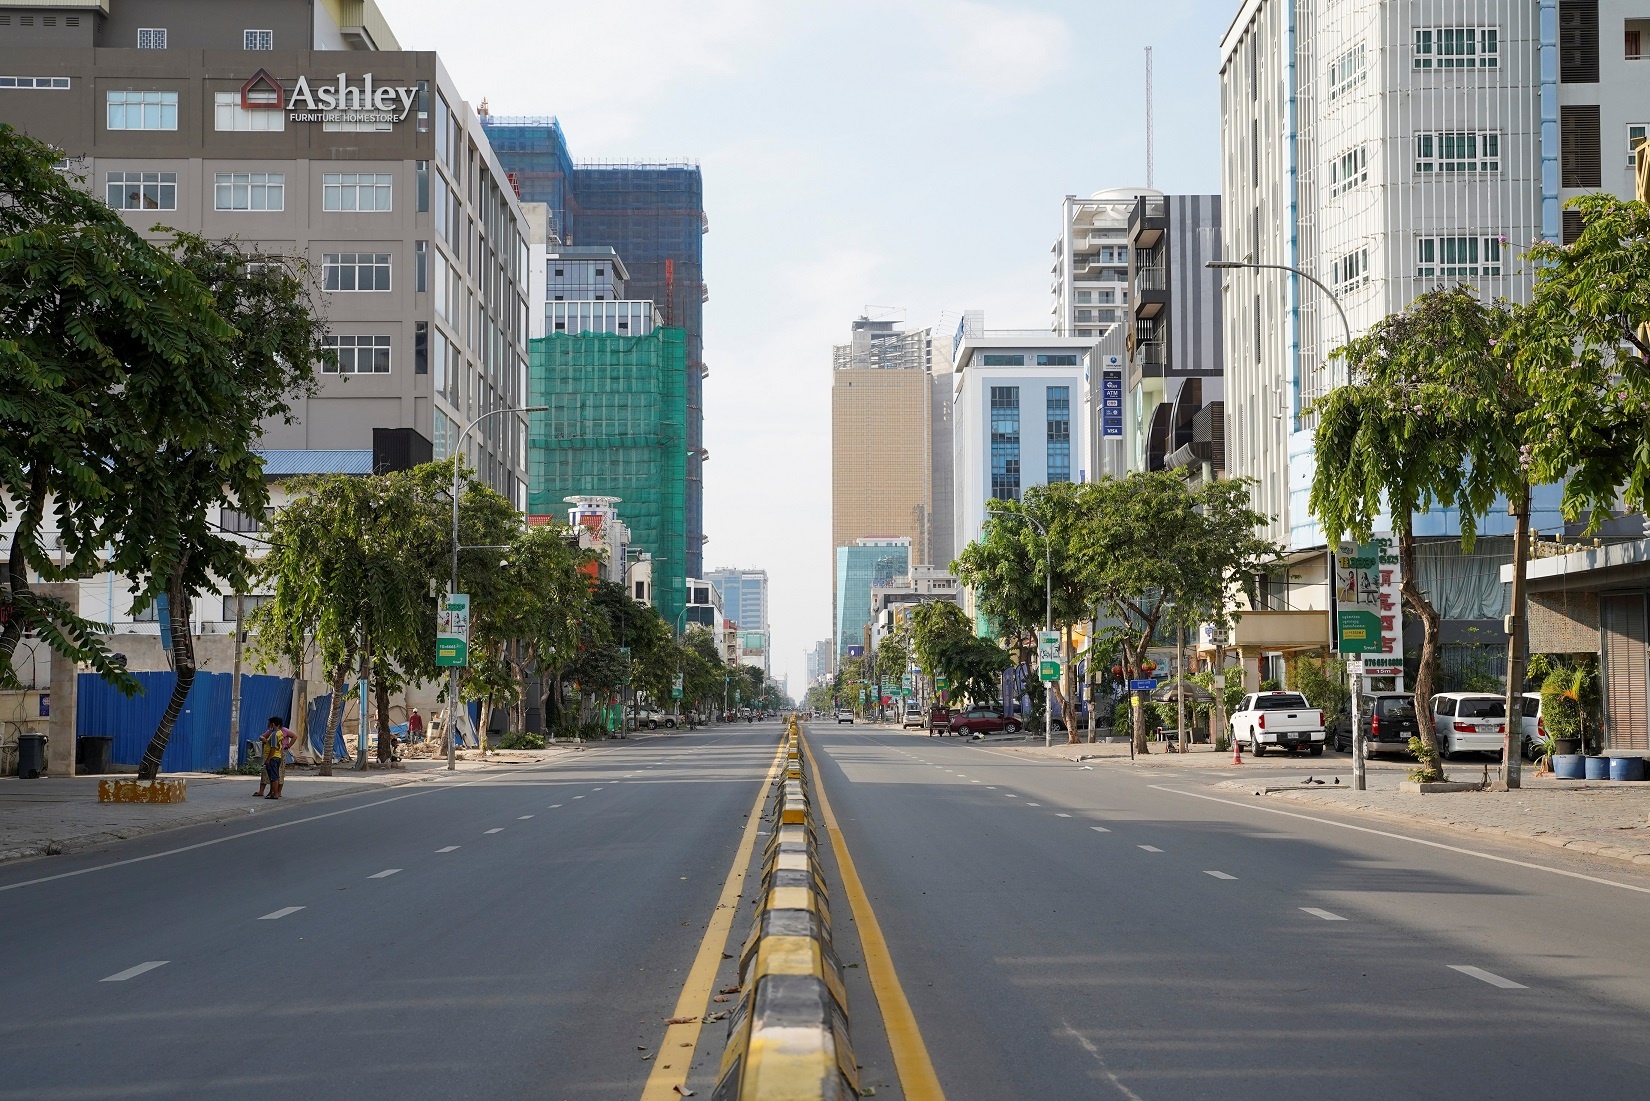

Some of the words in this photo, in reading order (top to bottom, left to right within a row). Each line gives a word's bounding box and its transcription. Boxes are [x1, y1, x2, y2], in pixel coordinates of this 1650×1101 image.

[286, 72, 419, 121] Ashley
[290, 113, 341, 122] FURNITURE
[343, 114, 400, 122] HOMESTORE
